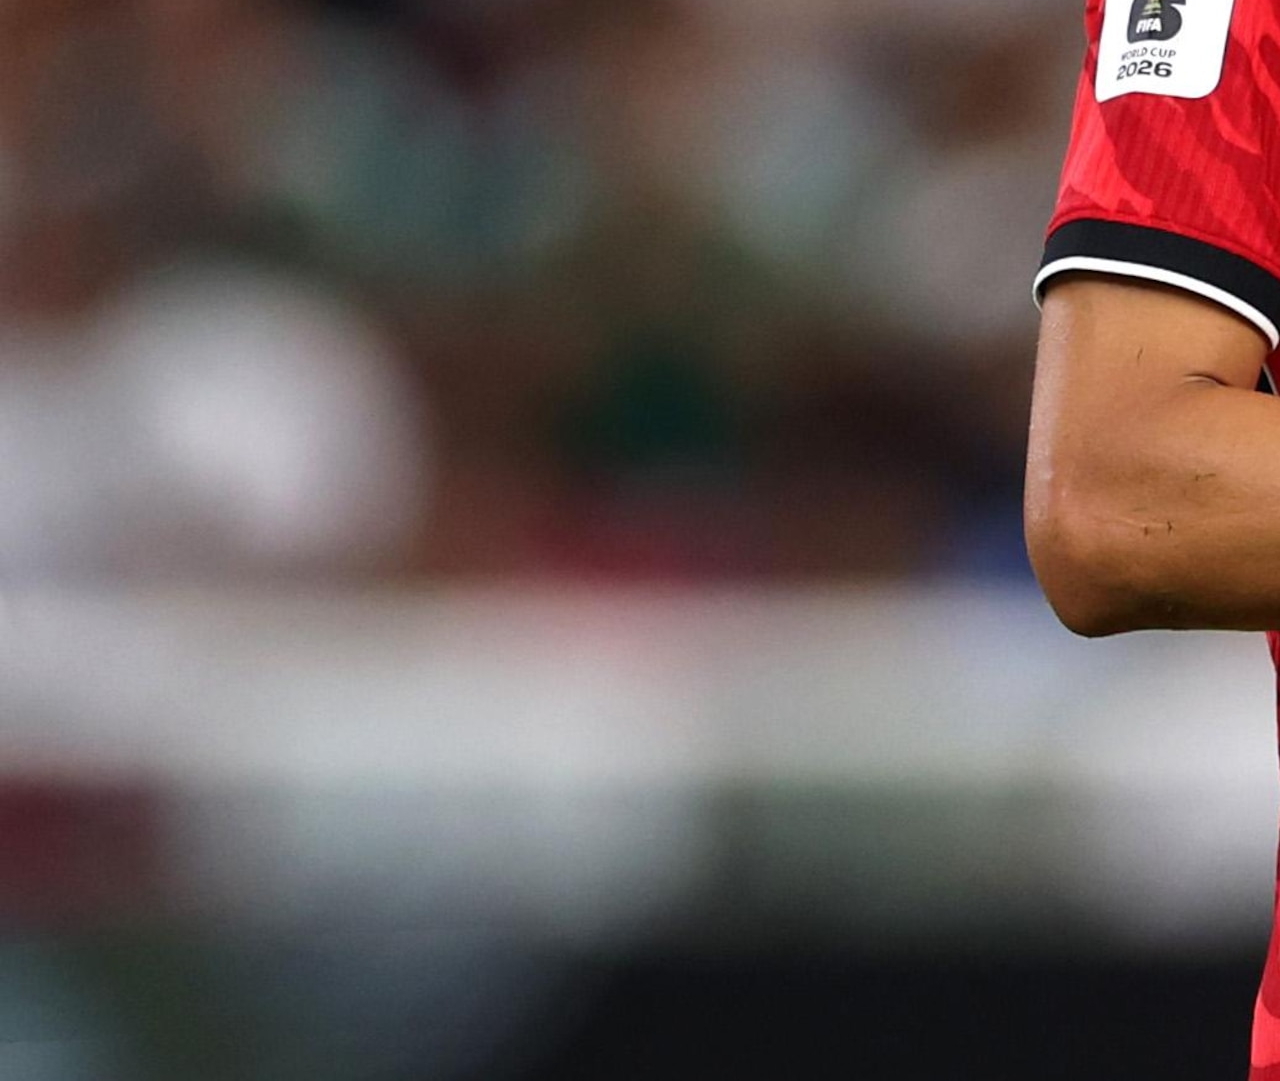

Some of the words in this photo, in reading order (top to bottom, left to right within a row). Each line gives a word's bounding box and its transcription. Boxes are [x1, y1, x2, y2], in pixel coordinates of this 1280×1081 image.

[1135, 17, 1162, 34] FIFA
[1121, 46, 1148, 61] WORLD
[1150, 47, 1176, 58] CUP
[1116, 60, 1172, 81] 2026
